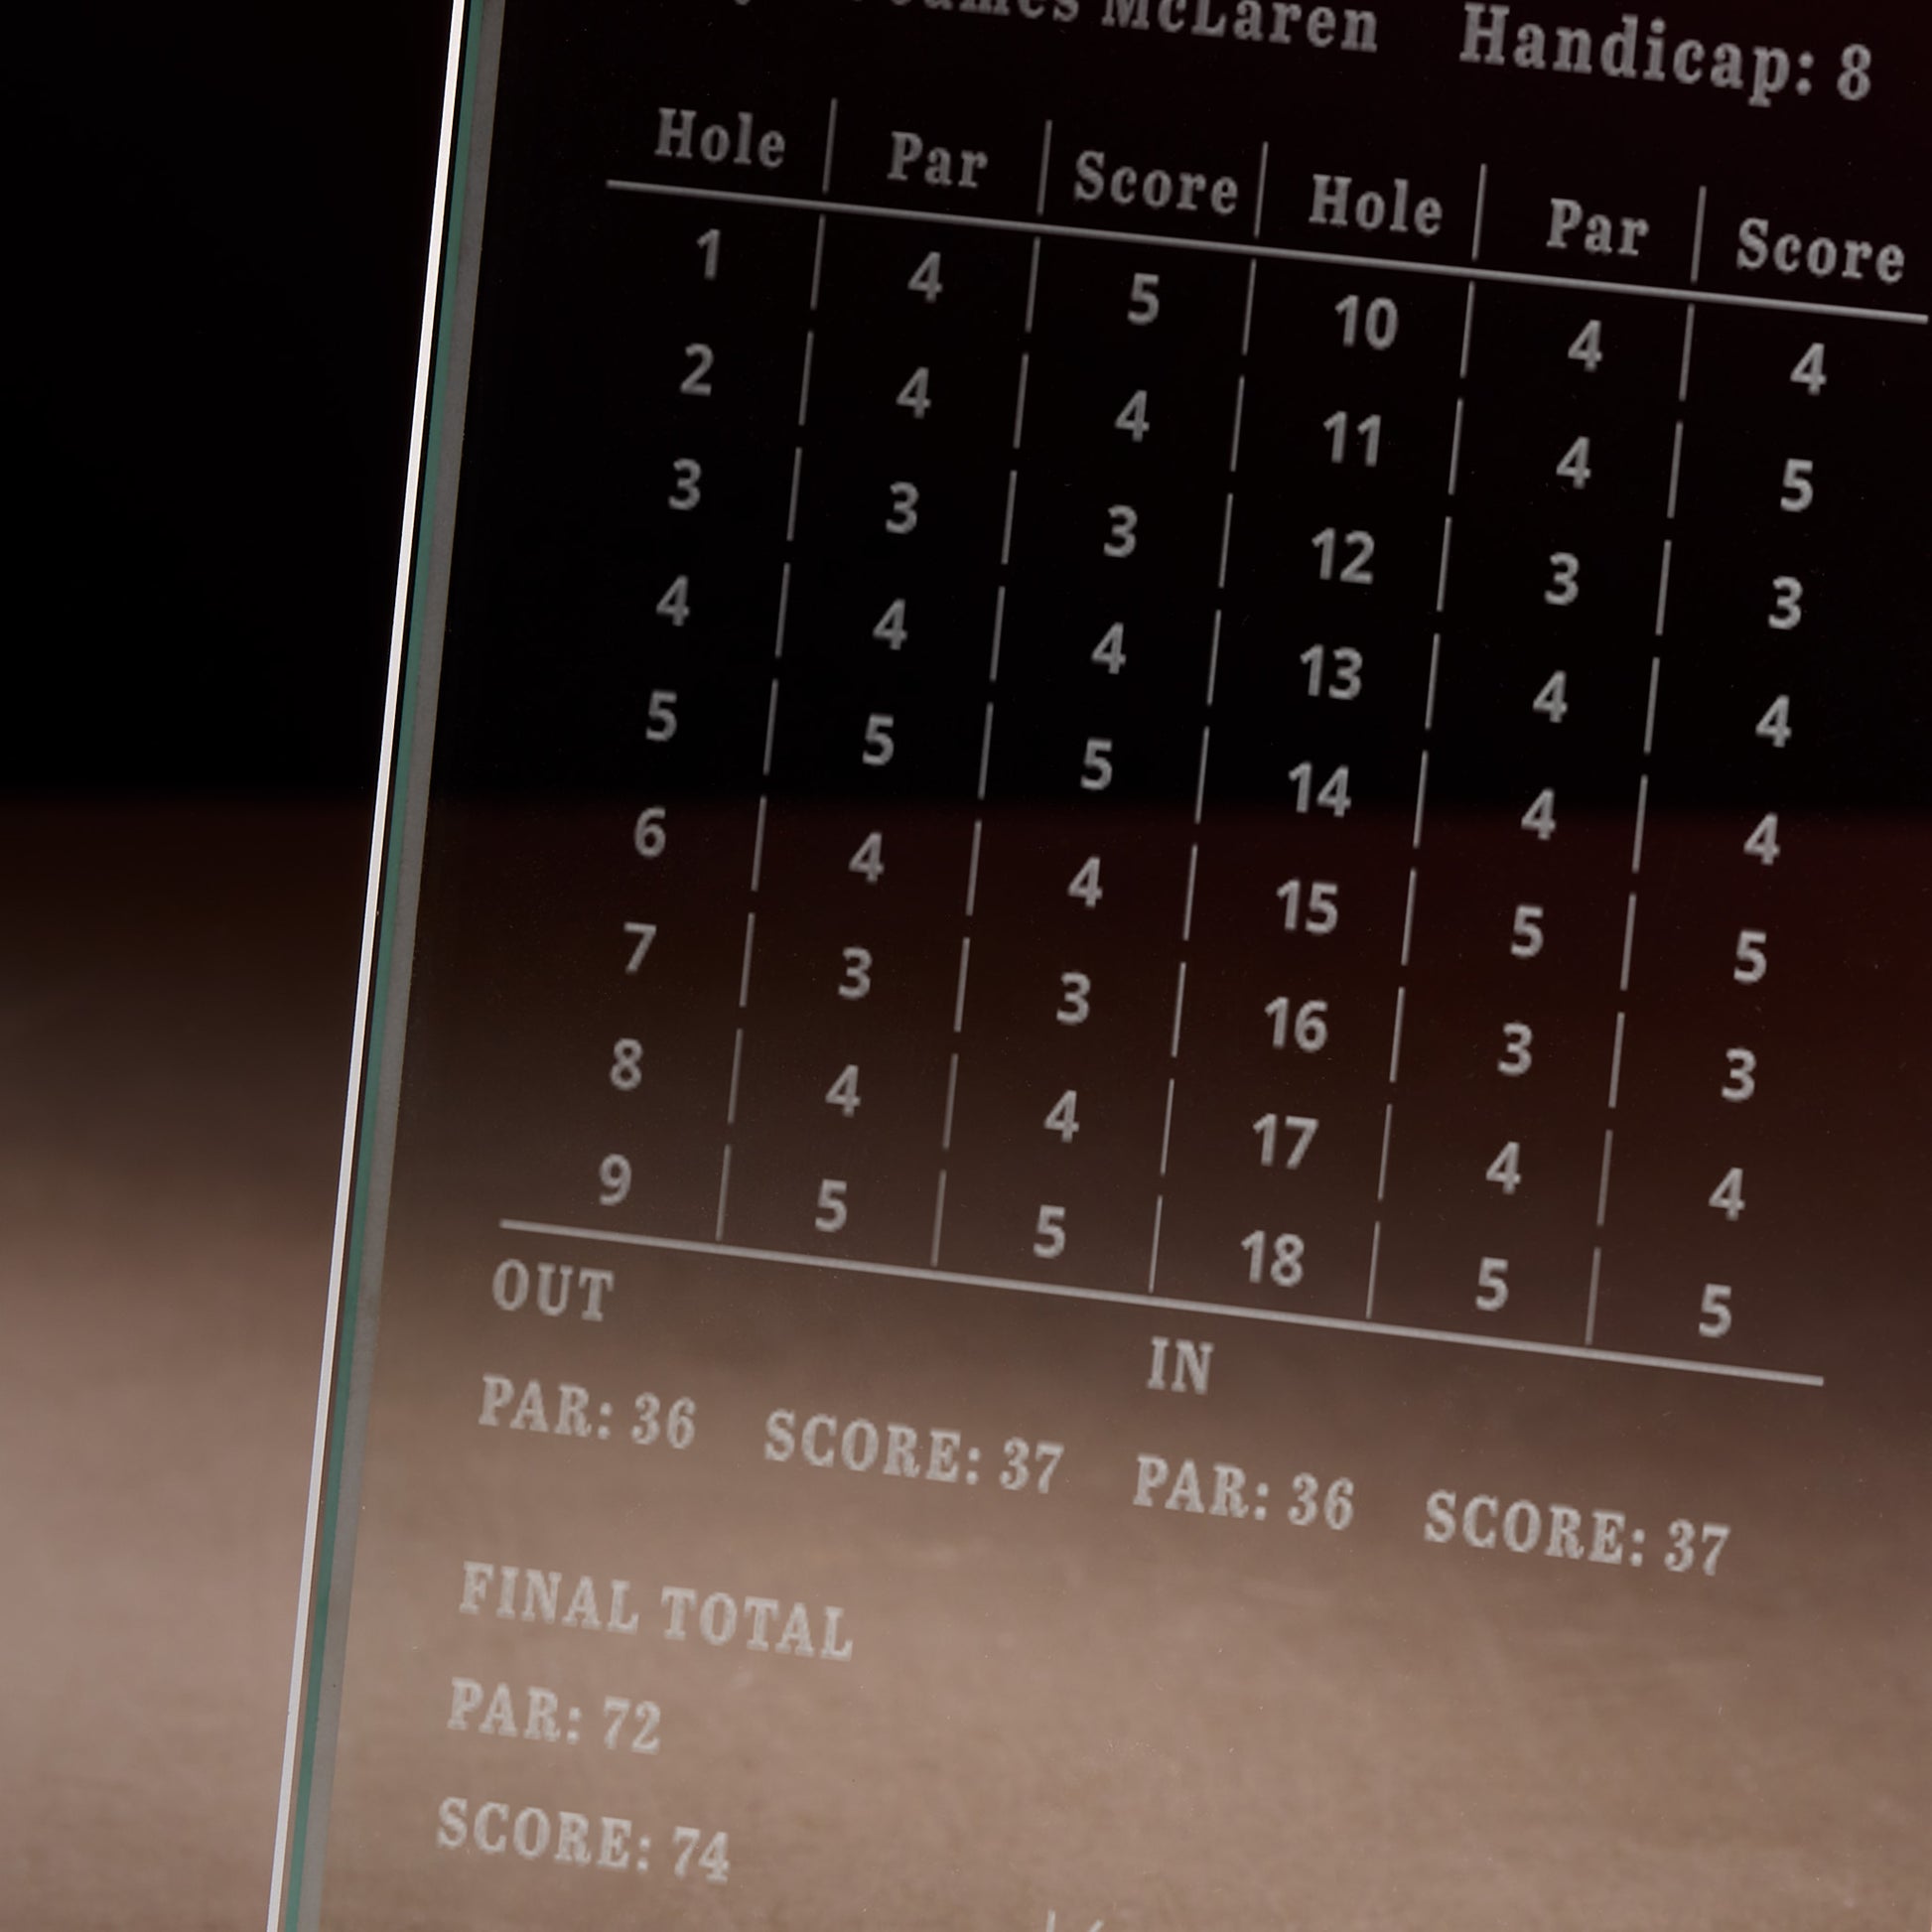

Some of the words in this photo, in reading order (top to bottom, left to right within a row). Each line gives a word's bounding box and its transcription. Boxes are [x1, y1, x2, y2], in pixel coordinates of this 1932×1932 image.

[1458, 1, 1815, 108] Handicap:
[1836, 43, 1872, 102] 8
[653, 106, 786, 169] Hole
[887, 130, 989, 190] Par
[1073, 149, 1239, 216] Score
[1308, 173, 1444, 237] Hole
[1545, 197, 1650, 257] Par
[1735, 216, 1906, 286] Score
[696, 227, 722, 280] 1
[906, 250, 943, 303] 4
[1126, 271, 1161, 326] 5
[1333, 293, 1399, 351] 10
[1567, 319, 1604, 372] 4
[1789, 342, 1828, 396] 4
[679, 343, 715, 397] 2
[896, 365, 932, 419] 4
[1114, 389, 1151, 443] 4
[1322, 410, 1382, 468] 11
[1555, 435, 1592, 490] 4
[1779, 457, 1815, 513] 5
[667, 457, 702, 511] 3
[885, 481, 920, 535] 3
[1103, 503, 1139, 559] 3
[1311, 526, 1376, 586] 12
[1543, 551, 1581, 607] 3
[1767, 575, 1804, 631] 3
[655, 574, 691, 627] 4
[872, 598, 908, 651] 4
[1090, 621, 1128, 675] 4
[1299, 642, 1364, 701] 13
[1532, 669, 1569, 724] 4
[1754, 693, 1793, 749] 4
[644, 689, 678, 743] 5
[861, 712, 896, 767] 5
[1079, 737, 1114, 791] 5
[1288, 759, 1352, 819] 14
[1520, 786, 1558, 842] 4
[1742, 811, 1781, 867] 4
[633, 805, 667, 859] 6
[848, 831, 886, 884] 4
[1066, 855, 1104, 909] 4
[1276, 878, 1339, 936] 15
[1509, 902, 1545, 959] 5
[1732, 928, 1768, 985] 5
[622, 920, 657, 974] 7
[837, 945, 874, 1001] 3
[1055, 970, 1092, 1027] 3
[1264, 995, 1329, 1054] 16
[1496, 1021, 1534, 1077] 3
[1721, 1046, 1757, 1103] 3
[609, 1037, 644, 1091] 8
[824, 1063, 862, 1117] 4
[1043, 1089, 1080, 1143] 4
[1252, 1112, 1319, 1170] 17
[1484, 1140, 1522, 1195] 4
[1708, 1167, 1746, 1221] 4
[492, 1258, 615, 1321] OUT
[599, 1153, 632, 1206] 9
[814, 1177, 848, 1233] 5
[1033, 1203, 1066, 1259] 5
[1240, 1229, 1306, 1288] 18
[1474, 1256, 1509, 1312] 5
[1698, 1283, 1732, 1338] 5
[479, 1374, 613, 1440] PAR:
[631, 1392, 696, 1449] 36
[764, 1409, 981, 1485] SCORE:
[999, 1437, 1064, 1494] 37
[1147, 1335, 1214, 1395] IN
[1133, 1453, 1269, 1521] PAR:
[1288, 1472, 1354, 1531] 36
[1424, 1488, 1645, 1568] SCORE:
[1664, 1518, 1731, 1577] 37
[460, 1562, 640, 1631] FINAL
[660, 1586, 853, 1659] TOTAL
[449, 1678, 582, 1743] PAR:
[601, 1695, 662, 1753] 72
[438, 1797, 651, 1871] SCORE:
[671, 1825, 731, 1882] 74
